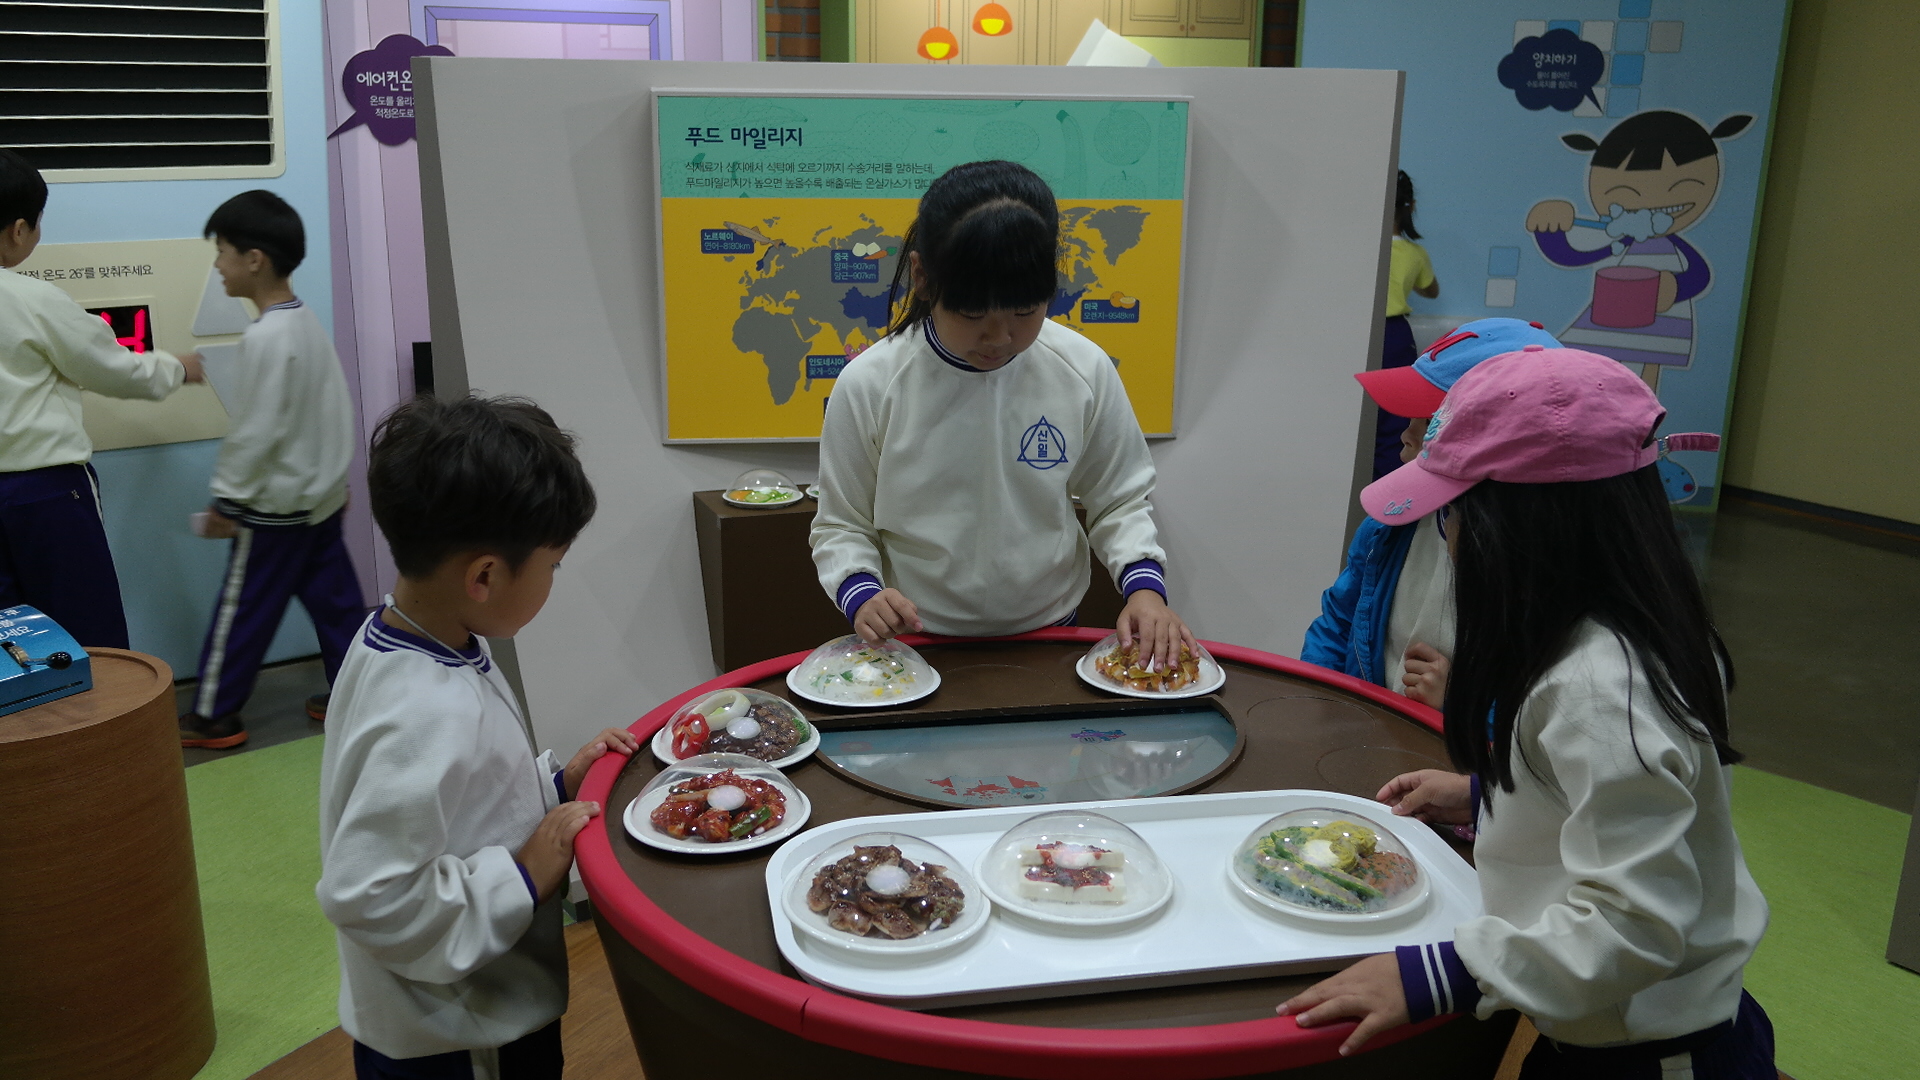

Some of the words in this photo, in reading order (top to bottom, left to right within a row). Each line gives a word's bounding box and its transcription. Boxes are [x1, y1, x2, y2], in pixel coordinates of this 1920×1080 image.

[1532, 52, 1577, 69] 양치하기
[369, 95, 395, 107] 온도를
[396, 95, 415, 107] 올리
[685, 127, 724, 147] 푸드
[730, 127, 803, 150] 마일리지
[685, 162, 724, 173] 식재료가
[726, 161, 764, 173] 산지에서
[766, 161, 795, 173] 식탁에
[798, 162, 845, 174] 오르기까지
[847, 162, 894, 174] 수송거리를
[685, 177, 752, 189] 푸드마일리지가
[754, 177, 783, 188] 높으면
[785, 177, 823, 189] 높을수록
[825, 177, 863, 189] 배출되는
[865, 177, 912, 190] 온실가스가
[703, 232, 734, 241] 노르웨이
[833, 252, 849, 262] 중국
[43, 269, 67, 282] 온도
[98, 264, 154, 279] 맞춰주세요
[1083, 302, 1099, 311] 미국
[808, 357, 845, 367] 인도네시아
